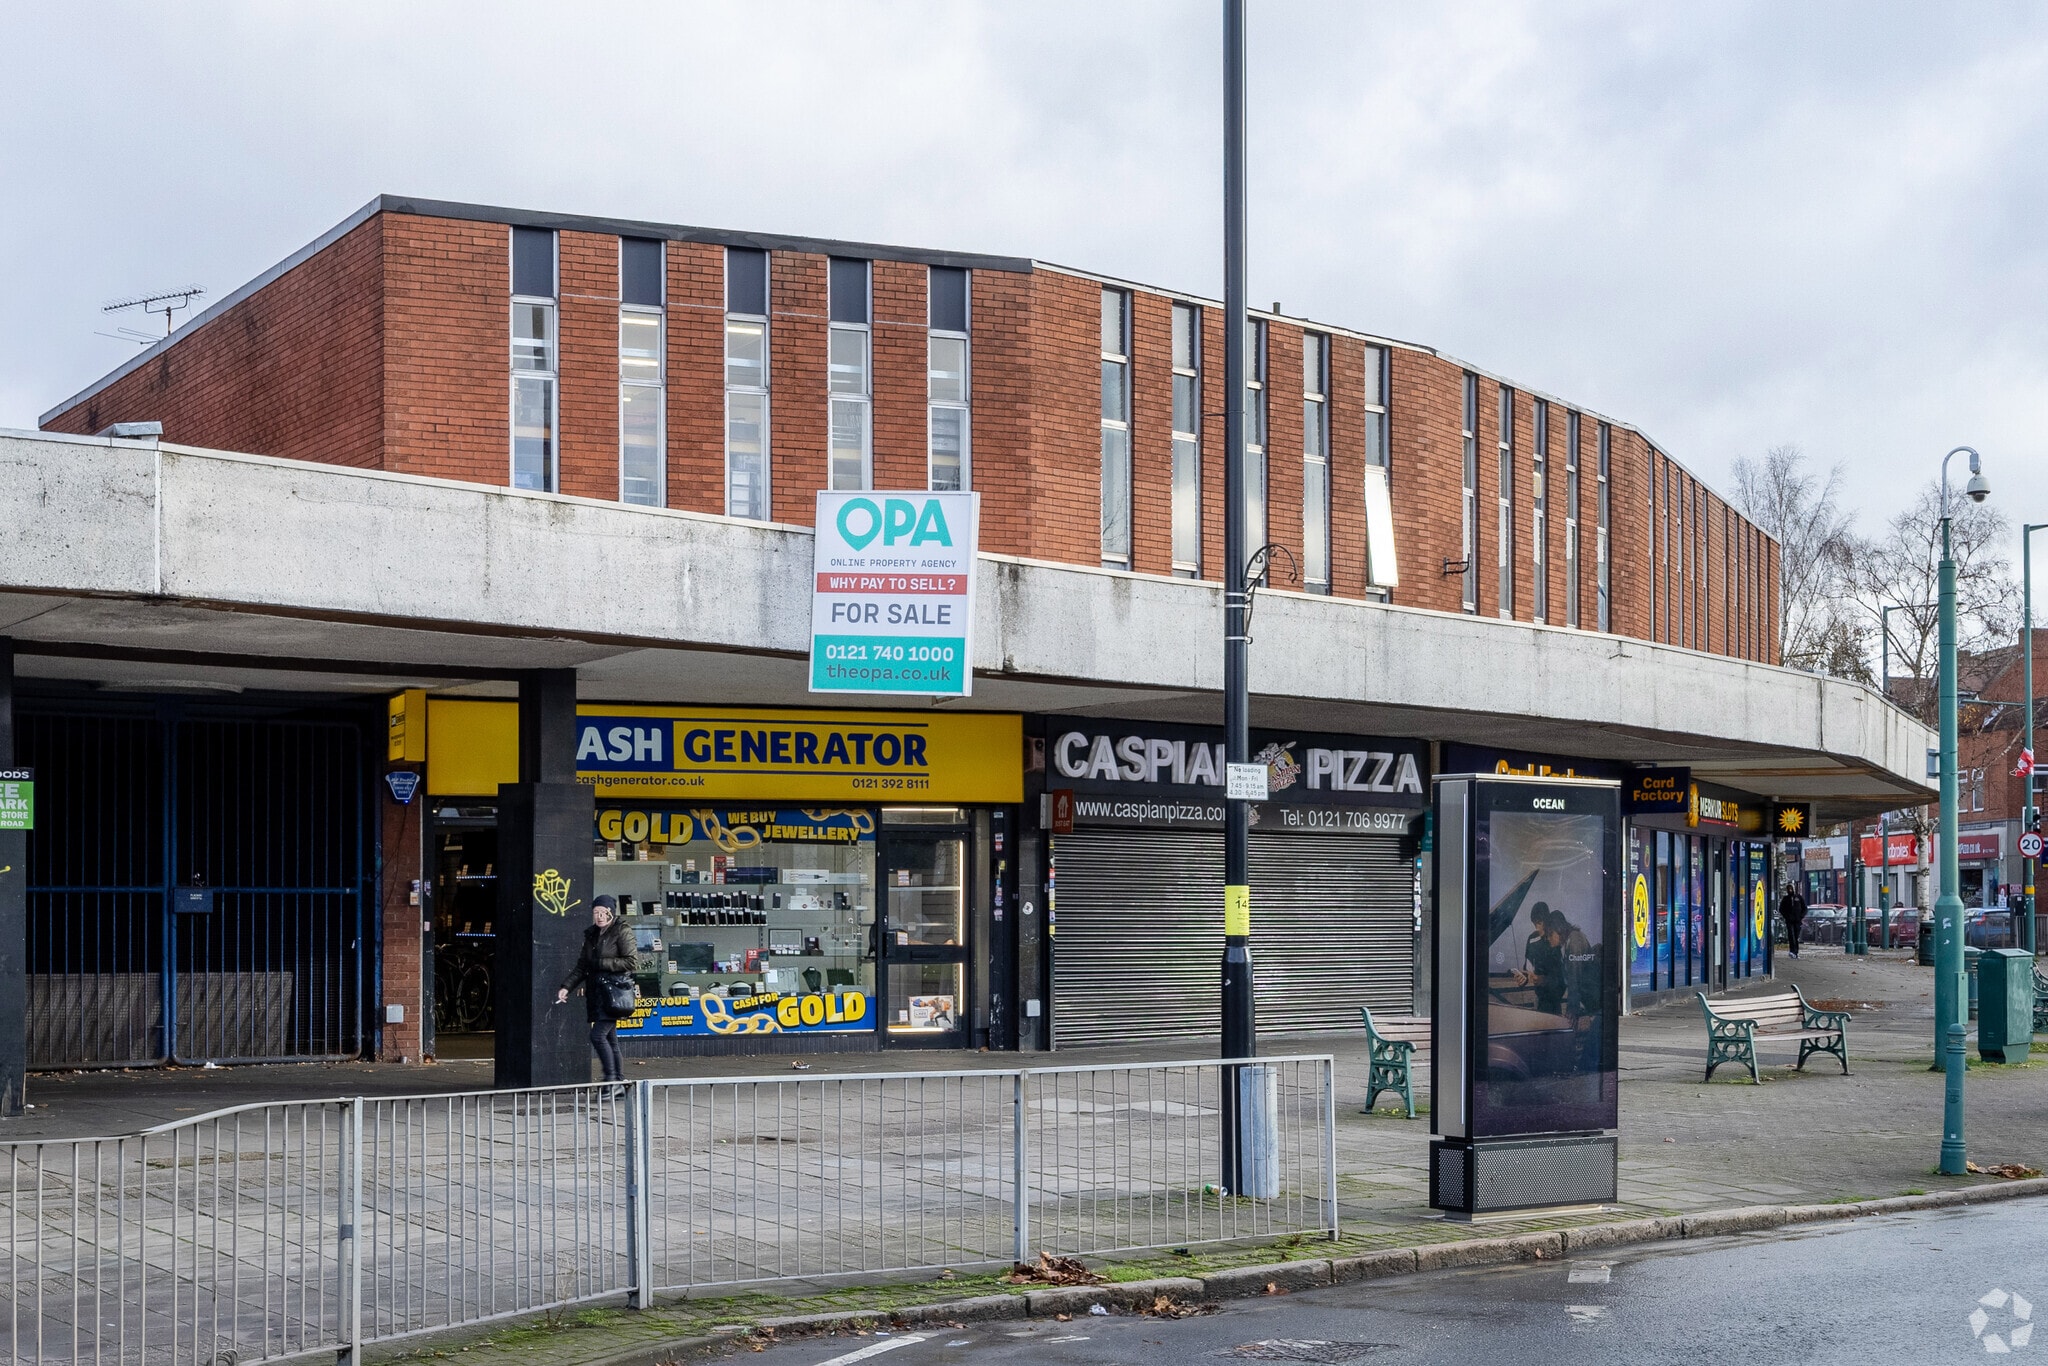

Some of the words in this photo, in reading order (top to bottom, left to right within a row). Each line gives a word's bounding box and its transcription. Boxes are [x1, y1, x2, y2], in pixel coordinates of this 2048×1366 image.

[836, 497, 953, 551] OPA
[830, 558, 866, 567] ONLINE
[870, 559, 917, 567] PROPERTY
[921, 559, 957, 568] AGENCY
[830, 577, 857, 589] WHY
[860, 577, 886, 590] PAY
[889, 578, 907, 590] TO
[910, 578, 956, 591] SELL?
[832, 602, 879, 624] FOR
[887, 603, 952, 625] SALE
[826, 645, 867, 660] 0121
[873, 646, 903, 661] 740
[908, 646, 954, 662] 1000
[827, 664, 951, 682] theopa.co.uk
[576, 726, 662, 762] ASH
[683, 728, 929, 766] GENERATOR
[0, 770, 29, 779] ODS
[1271, 764, 1301, 783] ASPIAN
[1306, 748, 1423, 794] PIZZA
[852, 778, 878, 788] 0121
[882, 779, 903, 789] 392
[906, 779, 929, 789] 8111
[1274, 774, 1297, 792] PIZZA
[1642, 776, 1675, 789] Card
[1533, 798, 1565, 810] OCEAN
[1633, 789, 1684, 803] Factory
[1, 811, 29, 819] STORE
[1699, 796, 1722, 820] MERKUR
[1721, 800, 1739, 822] SLOTS
[727, 812, 748, 825] WE
[749, 811, 776, 824] BUY
[1280, 809, 1304, 826] Tel:
[1308, 810, 1340, 827] 0121
[1345, 812, 1370, 828] 706
[1374, 813, 1405, 829] 9977
[600, 810, 693, 844] GOLD
[763, 825, 861, 841] JEWELLERY
[2022, 839, 2041, 850] 20
[1636, 899, 1646, 923] 24
[1568, 953, 1595, 962] ChatGPT
[659, 997, 690, 1007] YOUR
[733, 997, 758, 1010] CASH
[759, 992, 779, 1005] FOR
[777, 992, 866, 1027] GOLD
